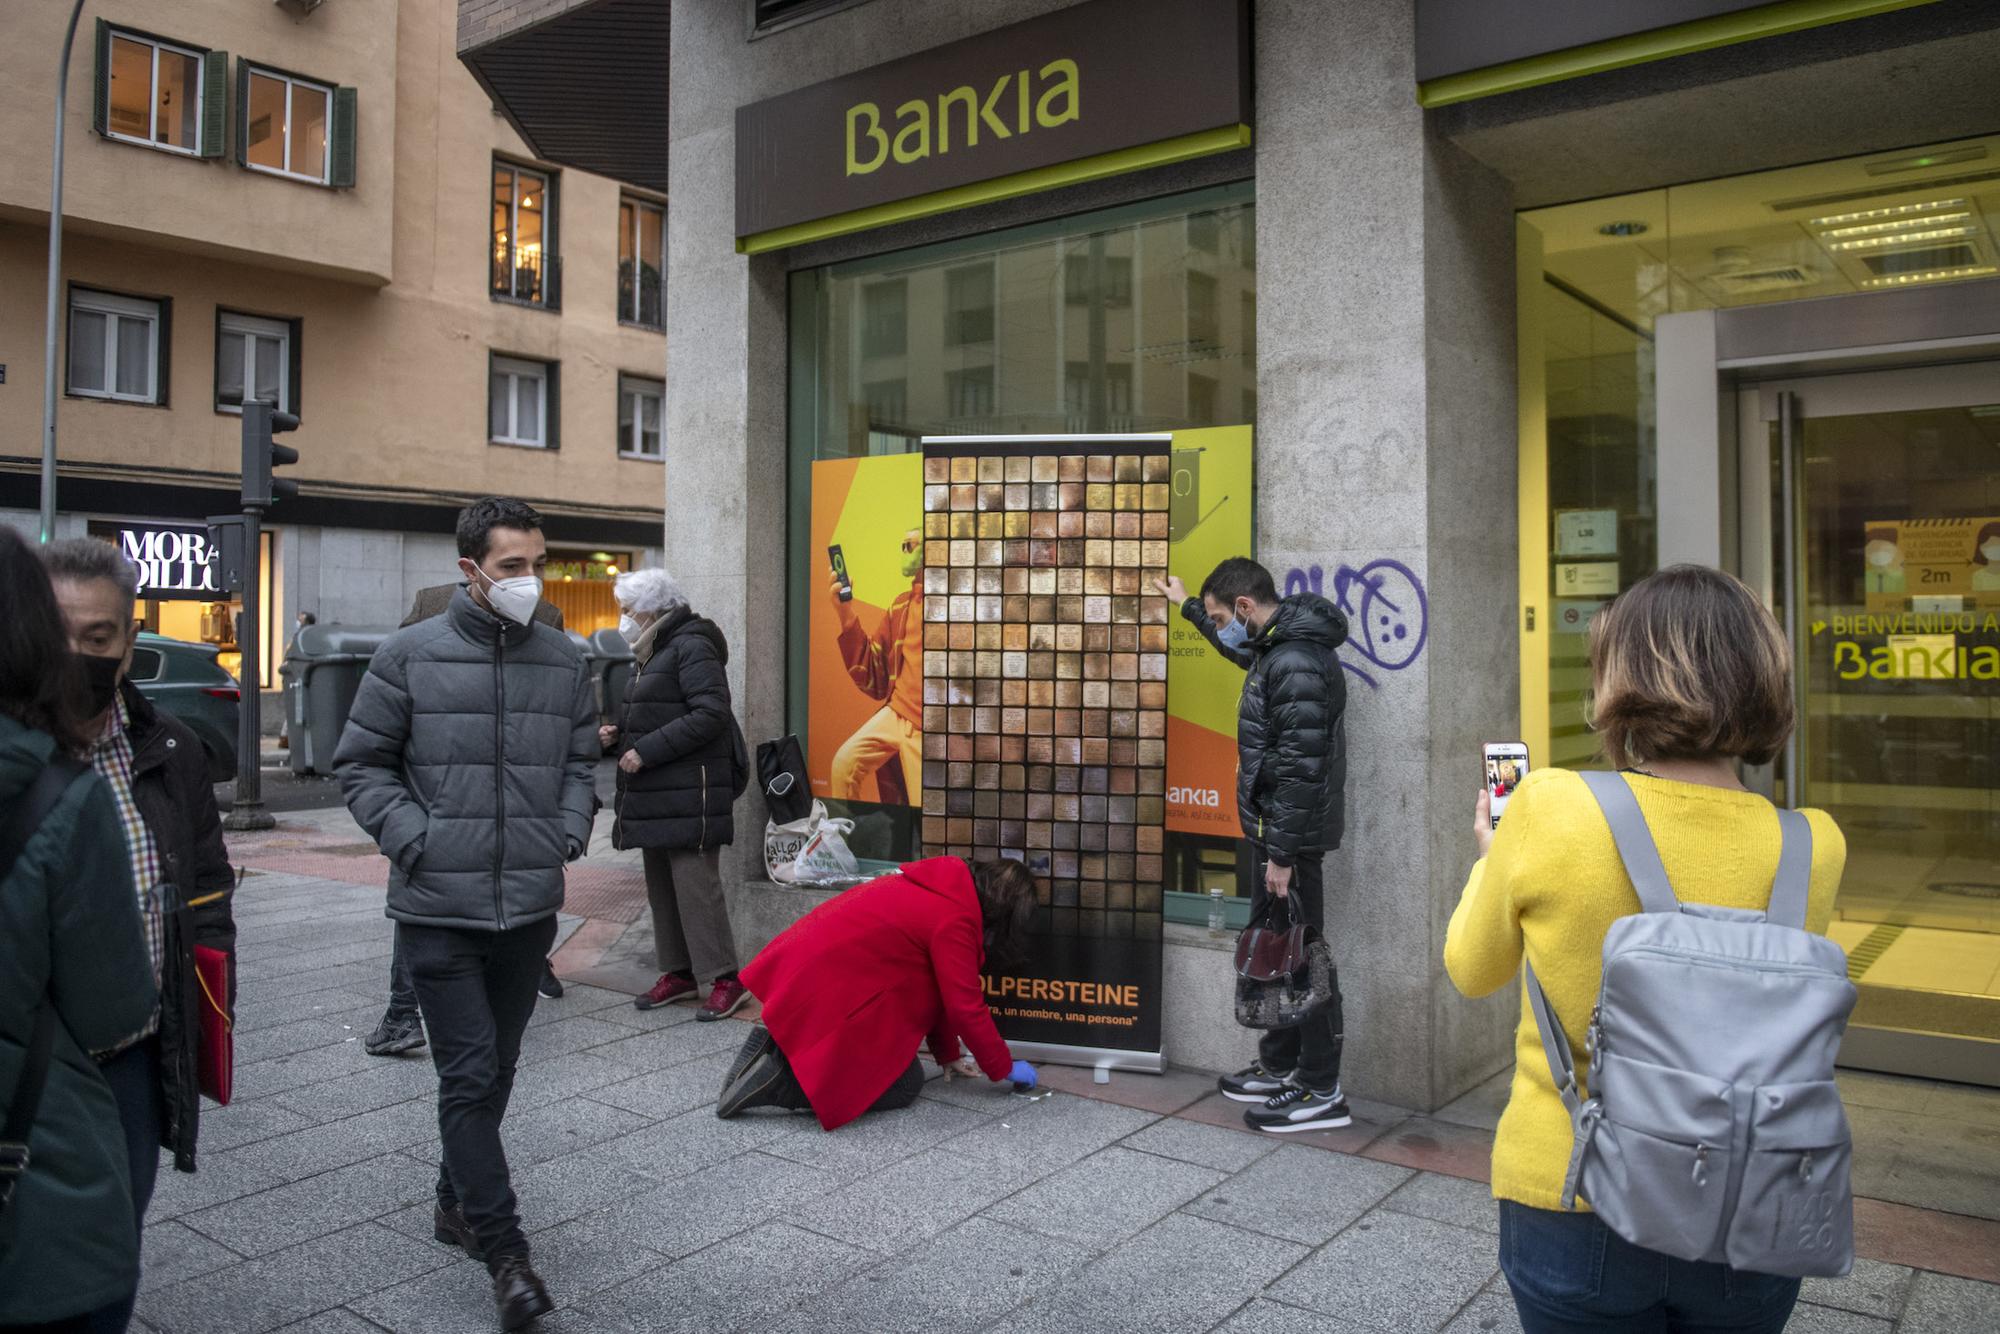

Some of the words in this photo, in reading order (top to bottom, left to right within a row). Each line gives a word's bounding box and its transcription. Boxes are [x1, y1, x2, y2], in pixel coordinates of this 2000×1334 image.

[846, 58, 1080, 177] Bankia
[1921, 568, 1951, 583] 2m
[1832, 612, 1975, 635] BIENVENIDO
[1983, 611, 2000, 633] A
[1173, 628, 1185, 641] de
[1834, 641, 2000, 680] Bankia
[1166, 786, 1219, 807] ankia
[1004, 1007, 1017, 1016] un
[1020, 1007, 1063, 1021] nombre,
[1066, 1012, 1086, 1022] una
